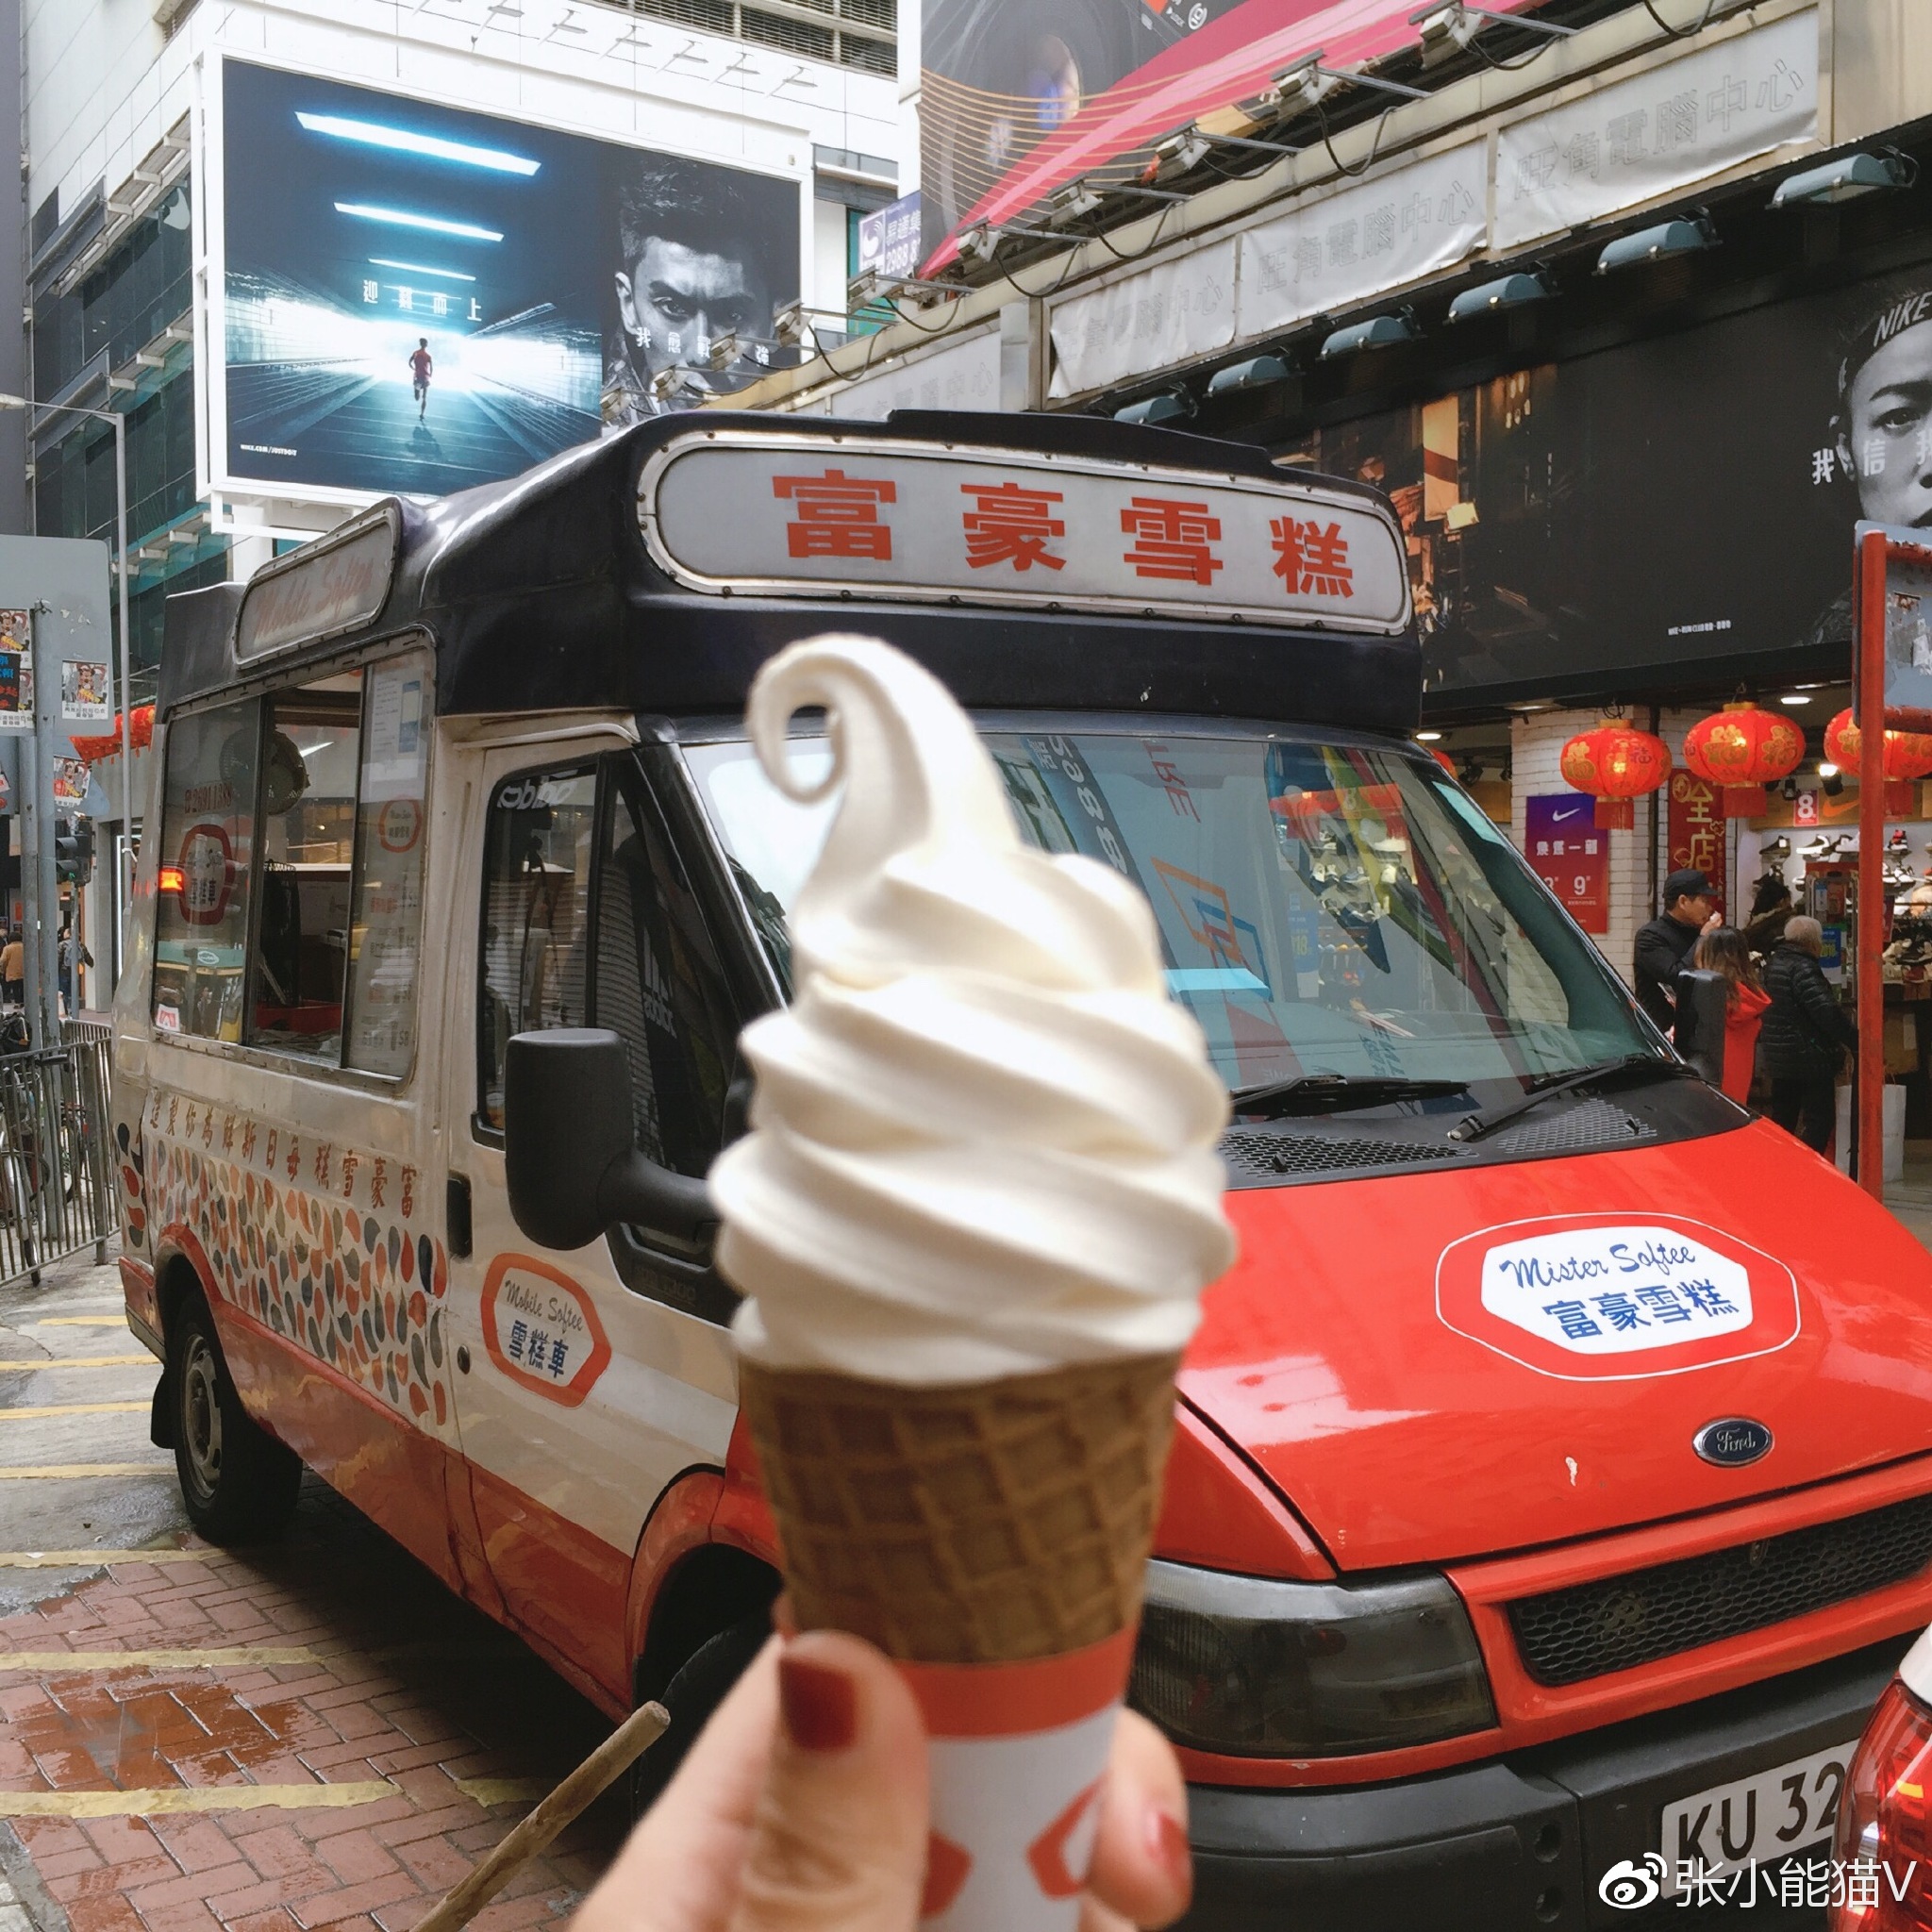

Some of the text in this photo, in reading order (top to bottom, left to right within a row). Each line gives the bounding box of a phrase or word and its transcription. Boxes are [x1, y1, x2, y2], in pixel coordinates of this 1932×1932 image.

[1514, 58, 1805, 201] 旺角電腦中心
[1257, 180, 1475, 295] 旺角電腦中心
[1874, 291, 1932, 348] NIKE
[773, 469, 1354, 599] 富豪雪糕
[1499, 1240, 1696, 1290] Mister Softee
[505, 1279, 584, 1335] Mobile Softee
[1541, 1278, 1740, 1341] 富豪雪糕
[508, 1319, 569, 1379] 雪糕車
[1716, 1427, 1757, 1454] Ford
[1677, 1790, 1757, 1882] KU
